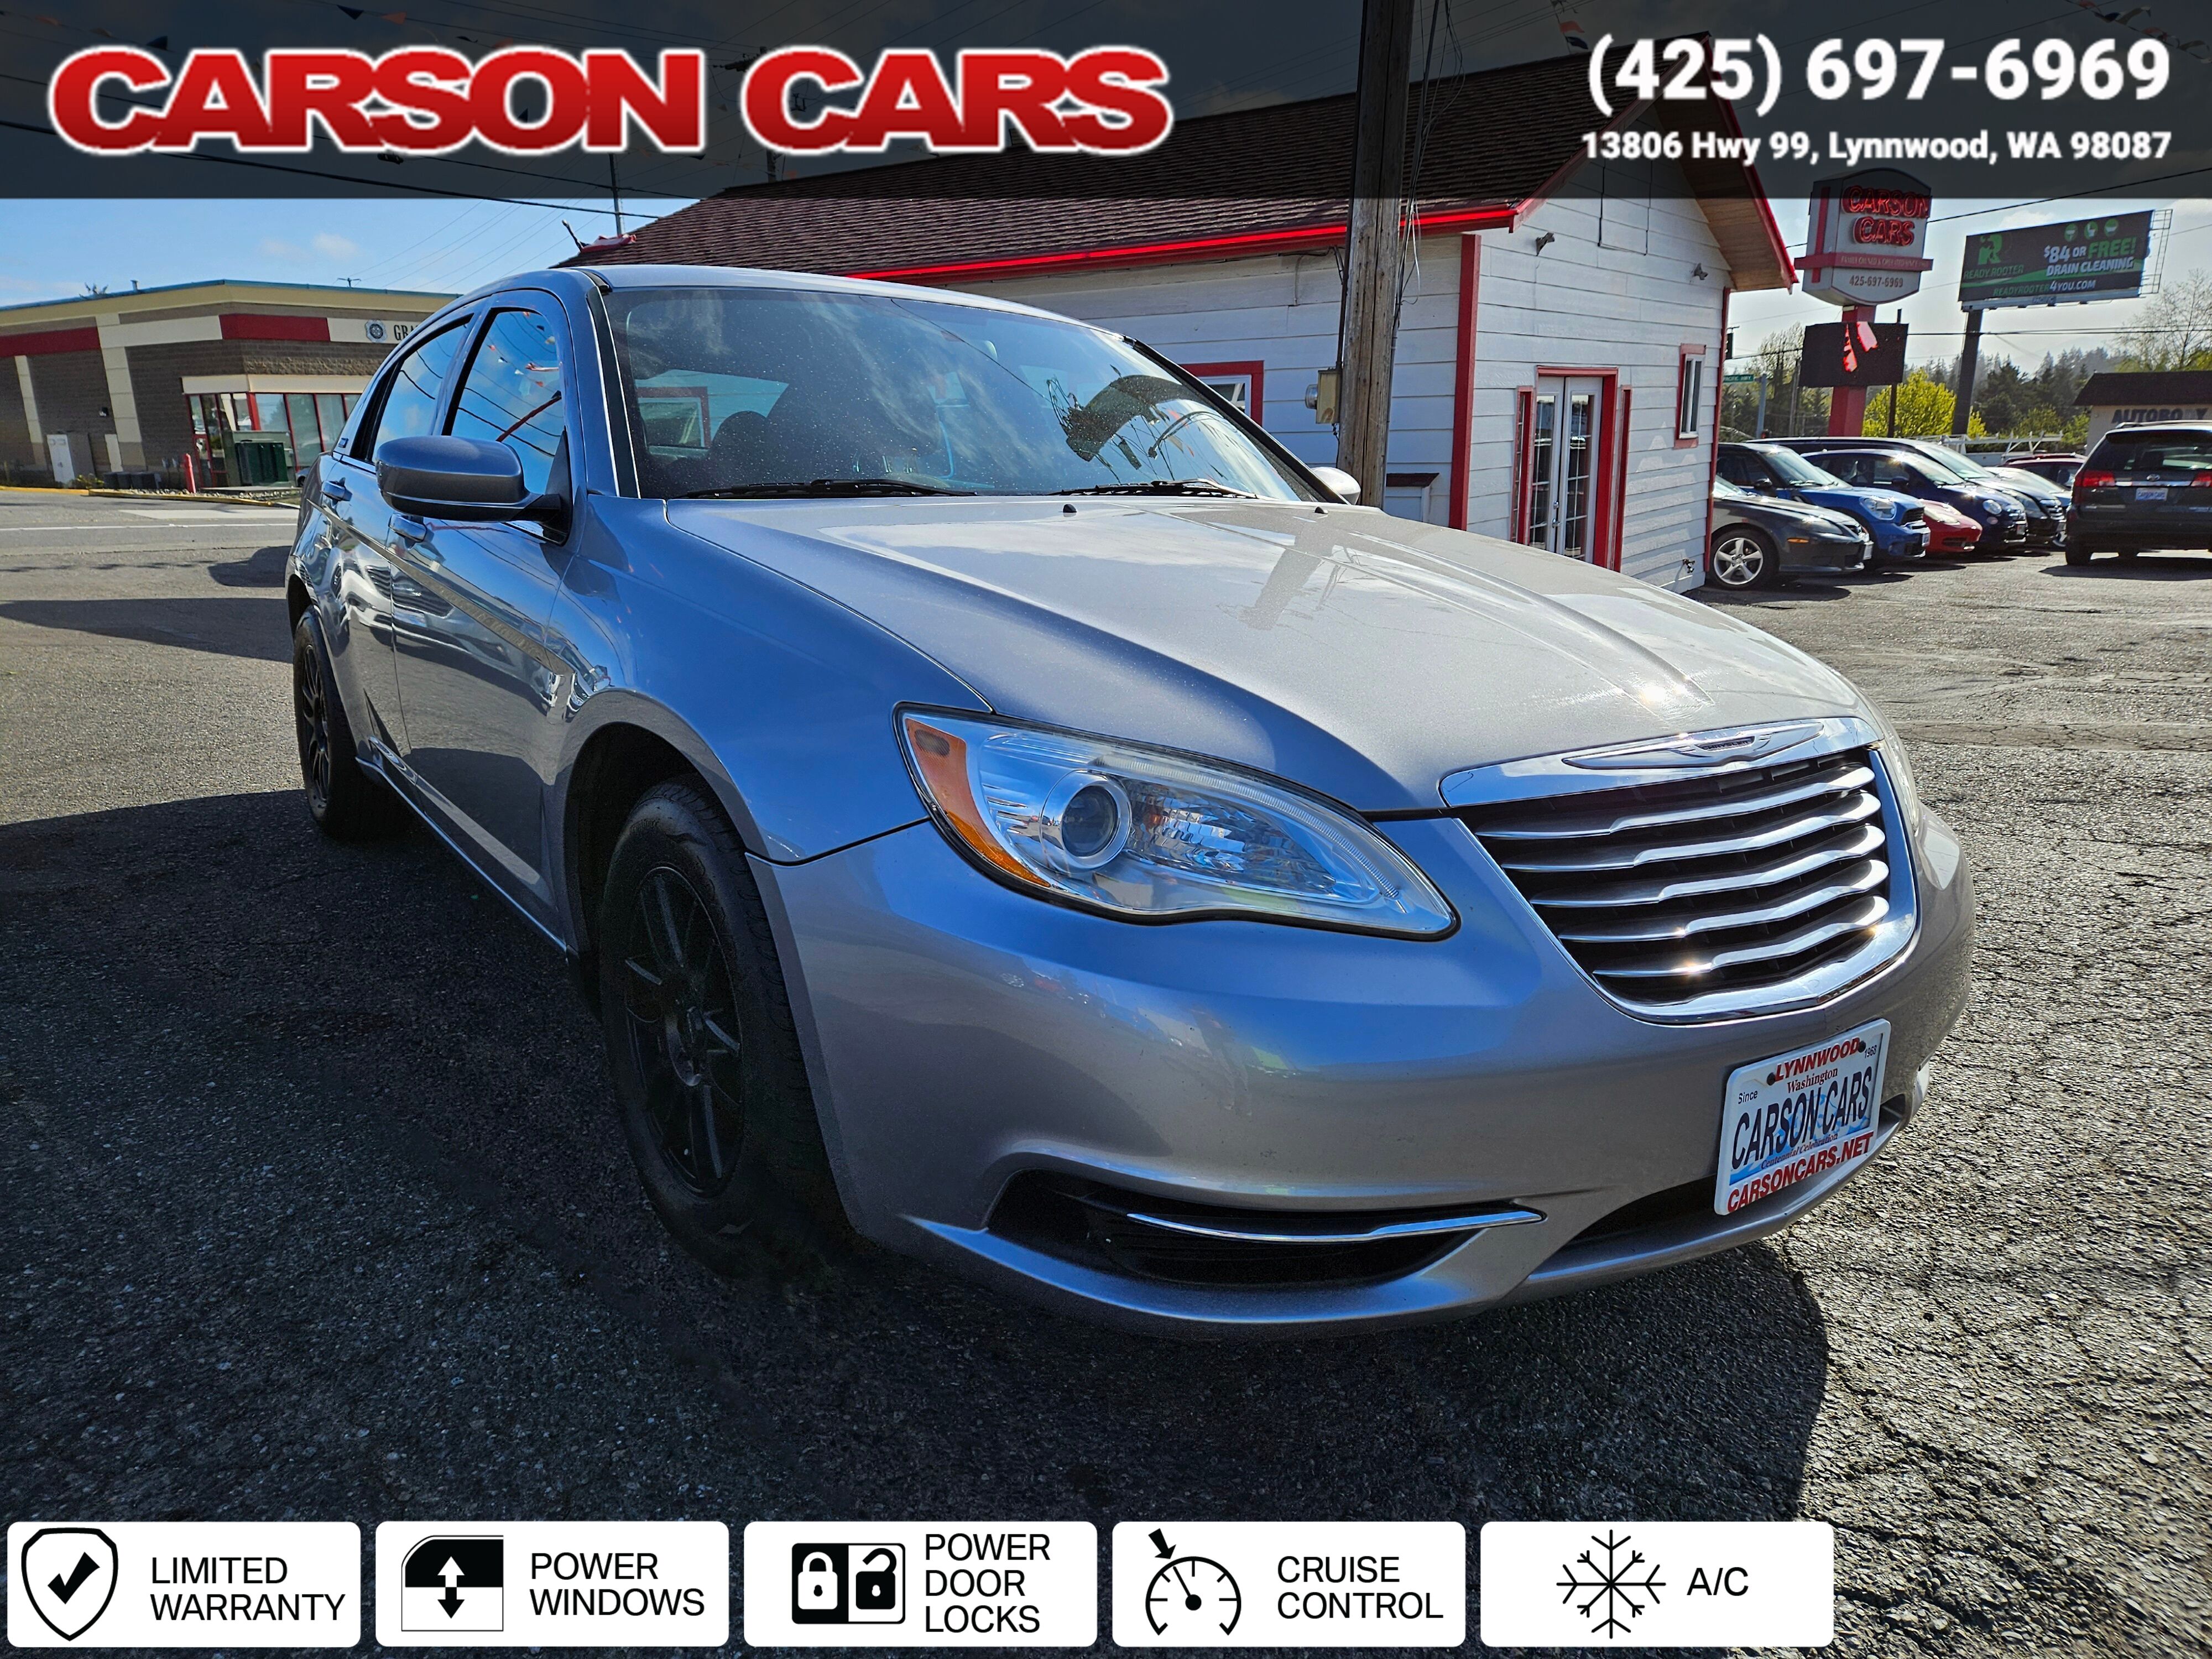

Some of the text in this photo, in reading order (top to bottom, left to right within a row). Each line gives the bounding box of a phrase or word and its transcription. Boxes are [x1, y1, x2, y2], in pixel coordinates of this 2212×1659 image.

[1843, 185, 1932, 218] CARSON
[1854, 217, 1915, 246] CARS
[2044, 237, 2137, 263] $84 OR FREE!
[1964, 264, 2024, 279] READY ROOTER
[2046, 256, 2134, 276] DRAIN CLEANING
[1849, 275, 1903, 288] 425-697-6969
[1702, 740, 1752, 750] CHRYSLER
[1775, 1037, 1860, 1082] LYNNWOOD
[1787, 1068, 1838, 1093] Washington
[1738, 1090, 1758, 1104] Since
[1731, 1066, 1872, 1170] CARSON CARS
[1761, 1133, 1838, 1170] Centennial Celebration
[1727, 1131, 1874, 1213] CARSONCARS.NET
